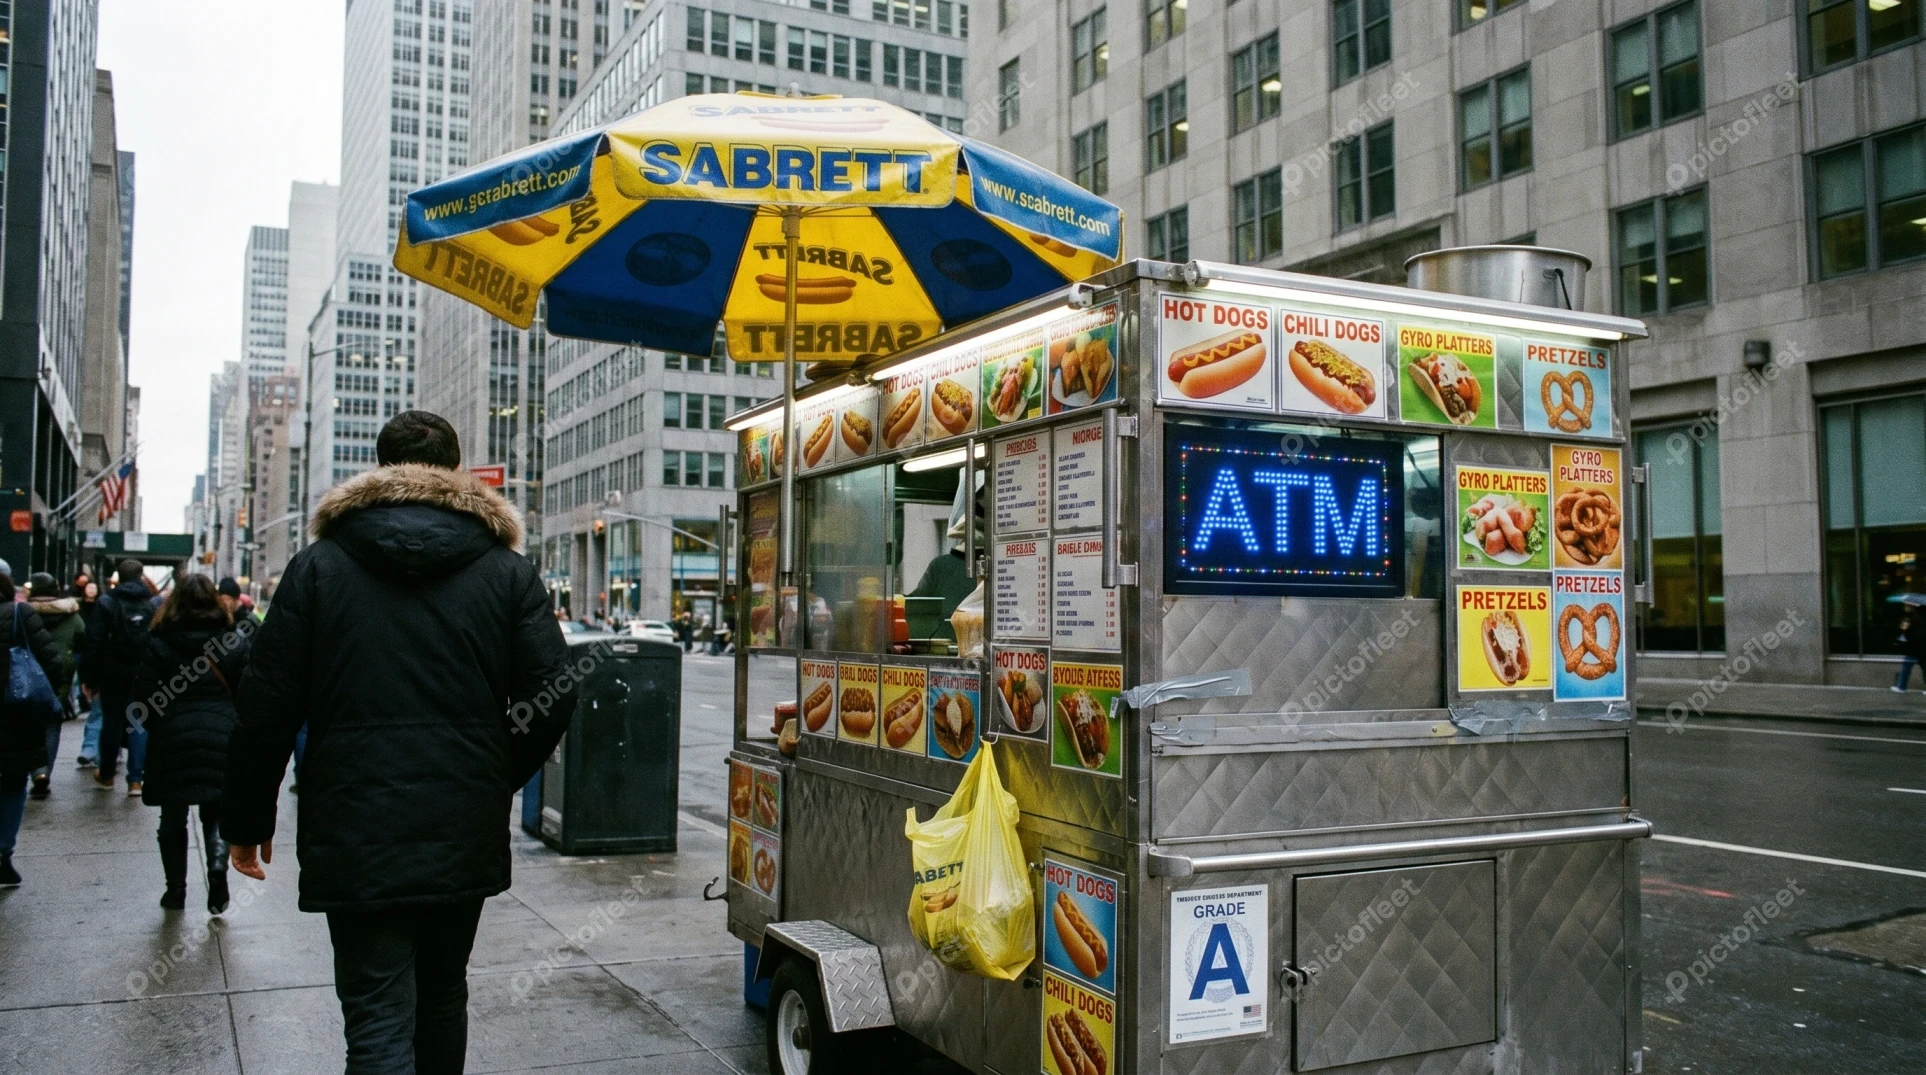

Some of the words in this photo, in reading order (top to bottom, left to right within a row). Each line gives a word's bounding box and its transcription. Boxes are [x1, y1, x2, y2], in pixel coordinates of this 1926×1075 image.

[689, 105, 881, 117] SABRETT
[640, 139, 931, 193] SABRETT
[1165, 299, 1206, 322] HOT
[1214, 305, 1268, 330] DOGS
[1284, 314, 1329, 338] CHILI
[1335, 320, 1380, 343] DOGS
[1401, 329, 1432, 349] GYRO
[1437, 333, 1492, 355] PLATTERS
[930, 358, 953, 381] CHILI
[954, 350, 978, 374] DOGS
[1528, 344, 1606, 370] PRETZELS
[882, 376, 900, 397] HOT
[901, 368, 924, 390] DOGS
[1572, 450, 1602, 466] GYRO
[1459, 471, 1490, 490] GYRO
[1493, 474, 1547, 493] PLATTERS
[1560, 467, 1613, 485] PLATTERS
[1193, 468, 1378, 556] ATM
[1556, 575, 1622, 594] PRETZELS
[1462, 591, 1547, 610] PRETZELS
[802, 663, 815, 677] HOT
[995, 651, 1015, 669] HOT
[1017, 653, 1046, 671] DOGS
[858, 667, 877, 683] DOGS
[883, 670, 901, 686] CHILI
[903, 671, 925, 689] DOGS
[1046, 864, 1072, 889] HOT
[1076, 874, 1115, 904] DOGS
[1226, 890, 1262, 899] DEPARTMENT
[1194, 901, 1245, 918] GRADE
[1189, 923, 1250, 1000] A
[1045, 976, 1074, 1006] CHILI
[1078, 991, 1112, 1024] DOGS
